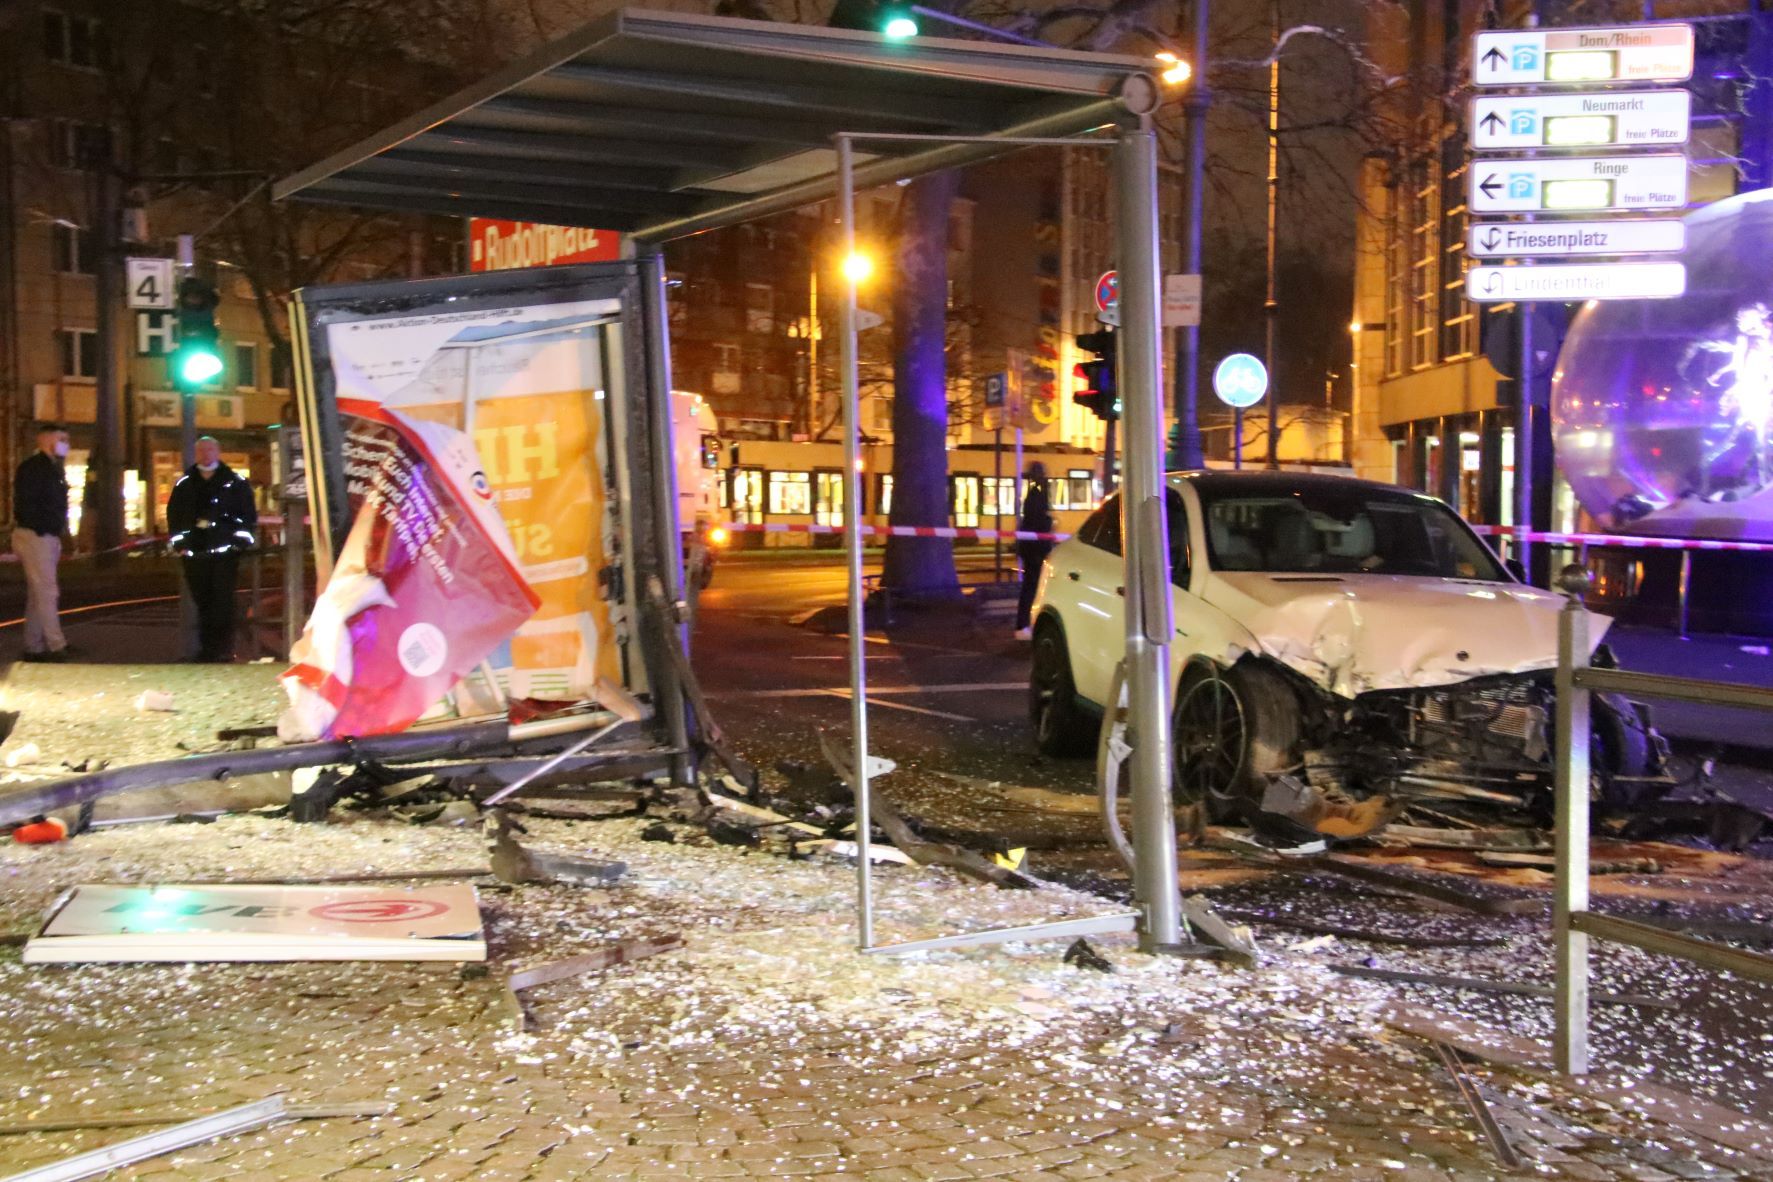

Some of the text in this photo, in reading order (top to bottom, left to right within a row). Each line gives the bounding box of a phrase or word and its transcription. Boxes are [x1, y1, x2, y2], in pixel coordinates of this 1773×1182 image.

[1579, 33, 1653, 48] Dom/Rhein
[1582, 99, 1645, 112] Neumarkt
[1593, 162, 1630, 176] Ringe
[1507, 230, 1608, 249] Friesenplatz
[137, 275, 161, 303] 4
[138, 313, 178, 353] H
